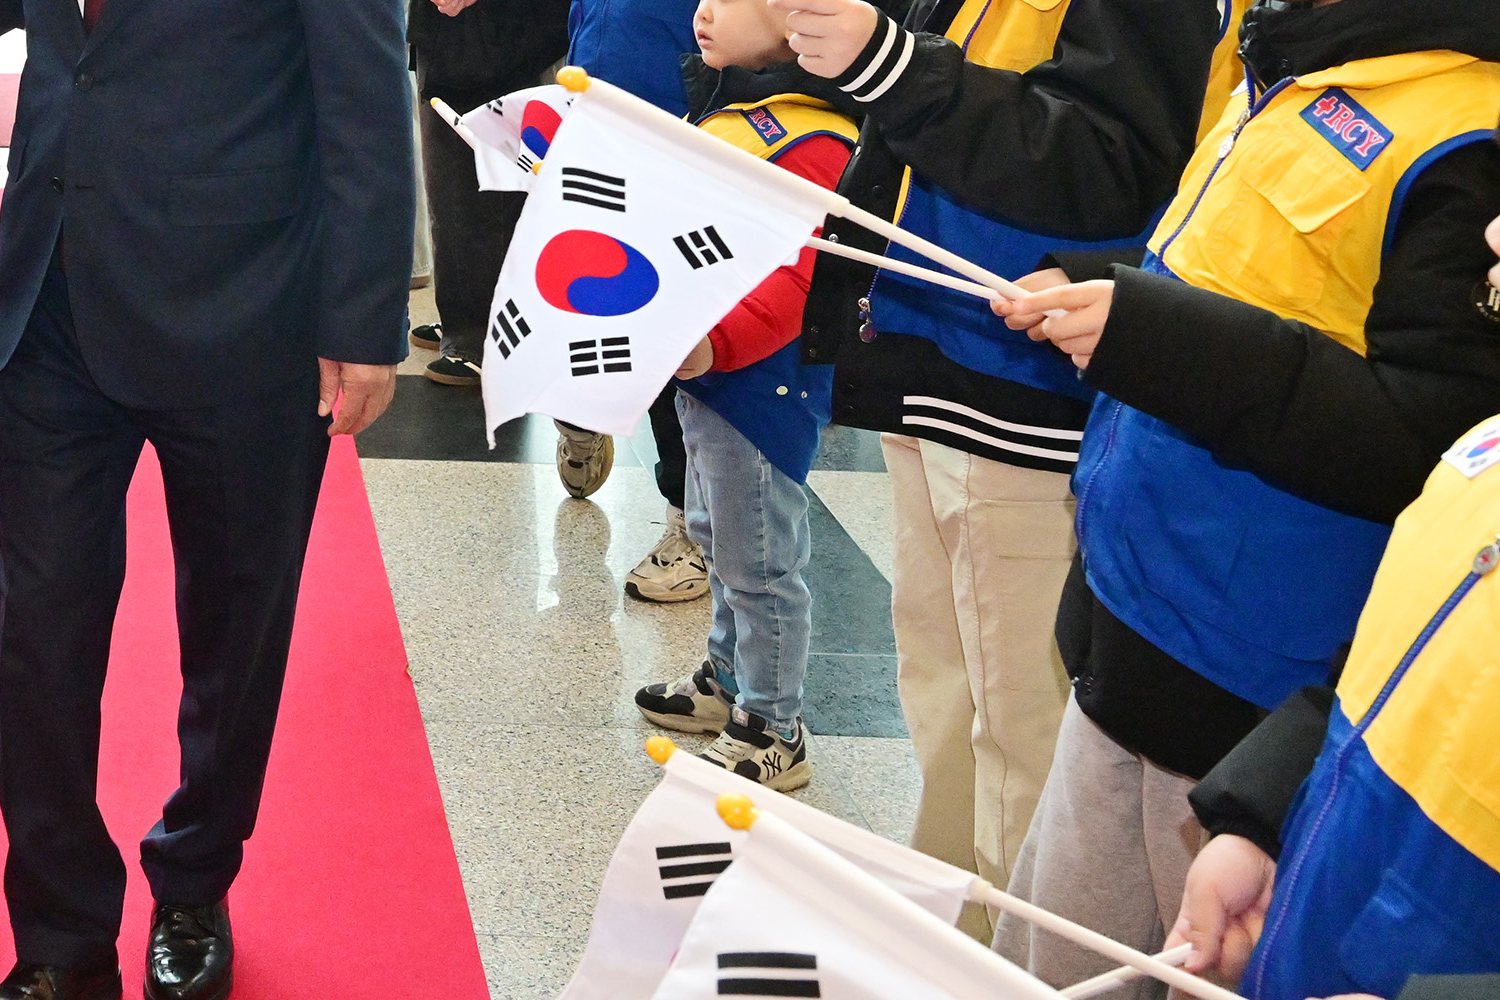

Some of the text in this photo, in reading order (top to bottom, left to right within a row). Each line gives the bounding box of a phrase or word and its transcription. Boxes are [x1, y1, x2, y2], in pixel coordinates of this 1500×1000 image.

[749, 108, 782, 139] RCY
[1322, 102, 1385, 157] RCY
[761, 750, 783, 780] NY
